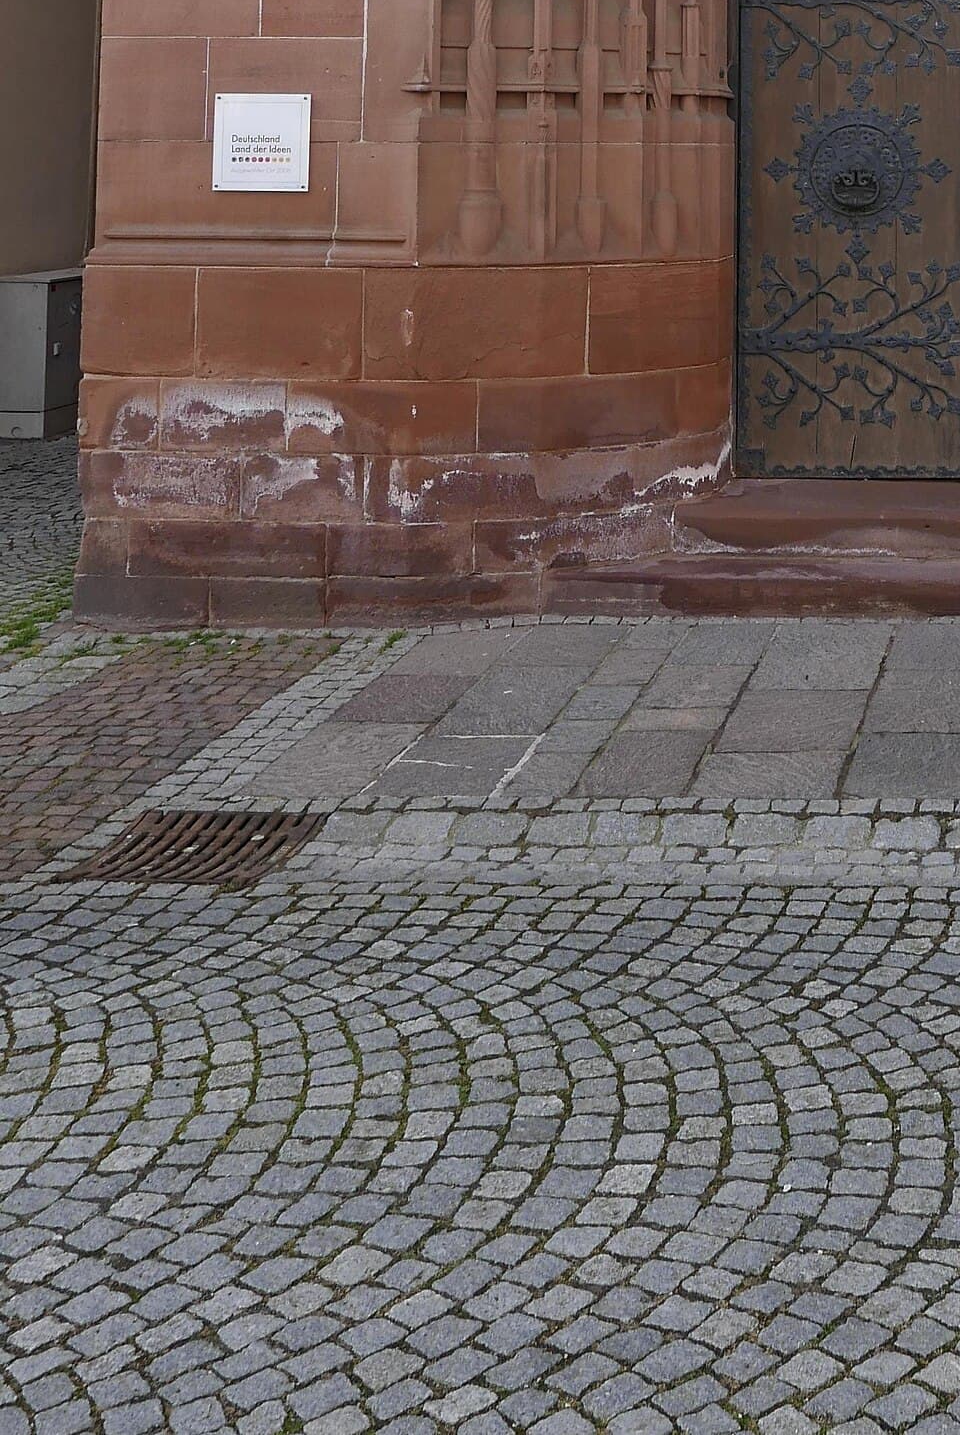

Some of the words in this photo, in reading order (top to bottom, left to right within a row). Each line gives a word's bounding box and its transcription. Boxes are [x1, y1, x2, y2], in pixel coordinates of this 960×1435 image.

[231, 134, 281, 143] Deutschland
[231, 145, 251, 153] Land
[253, 145, 267, 153] der
[269, 145, 292, 153] Ideen
